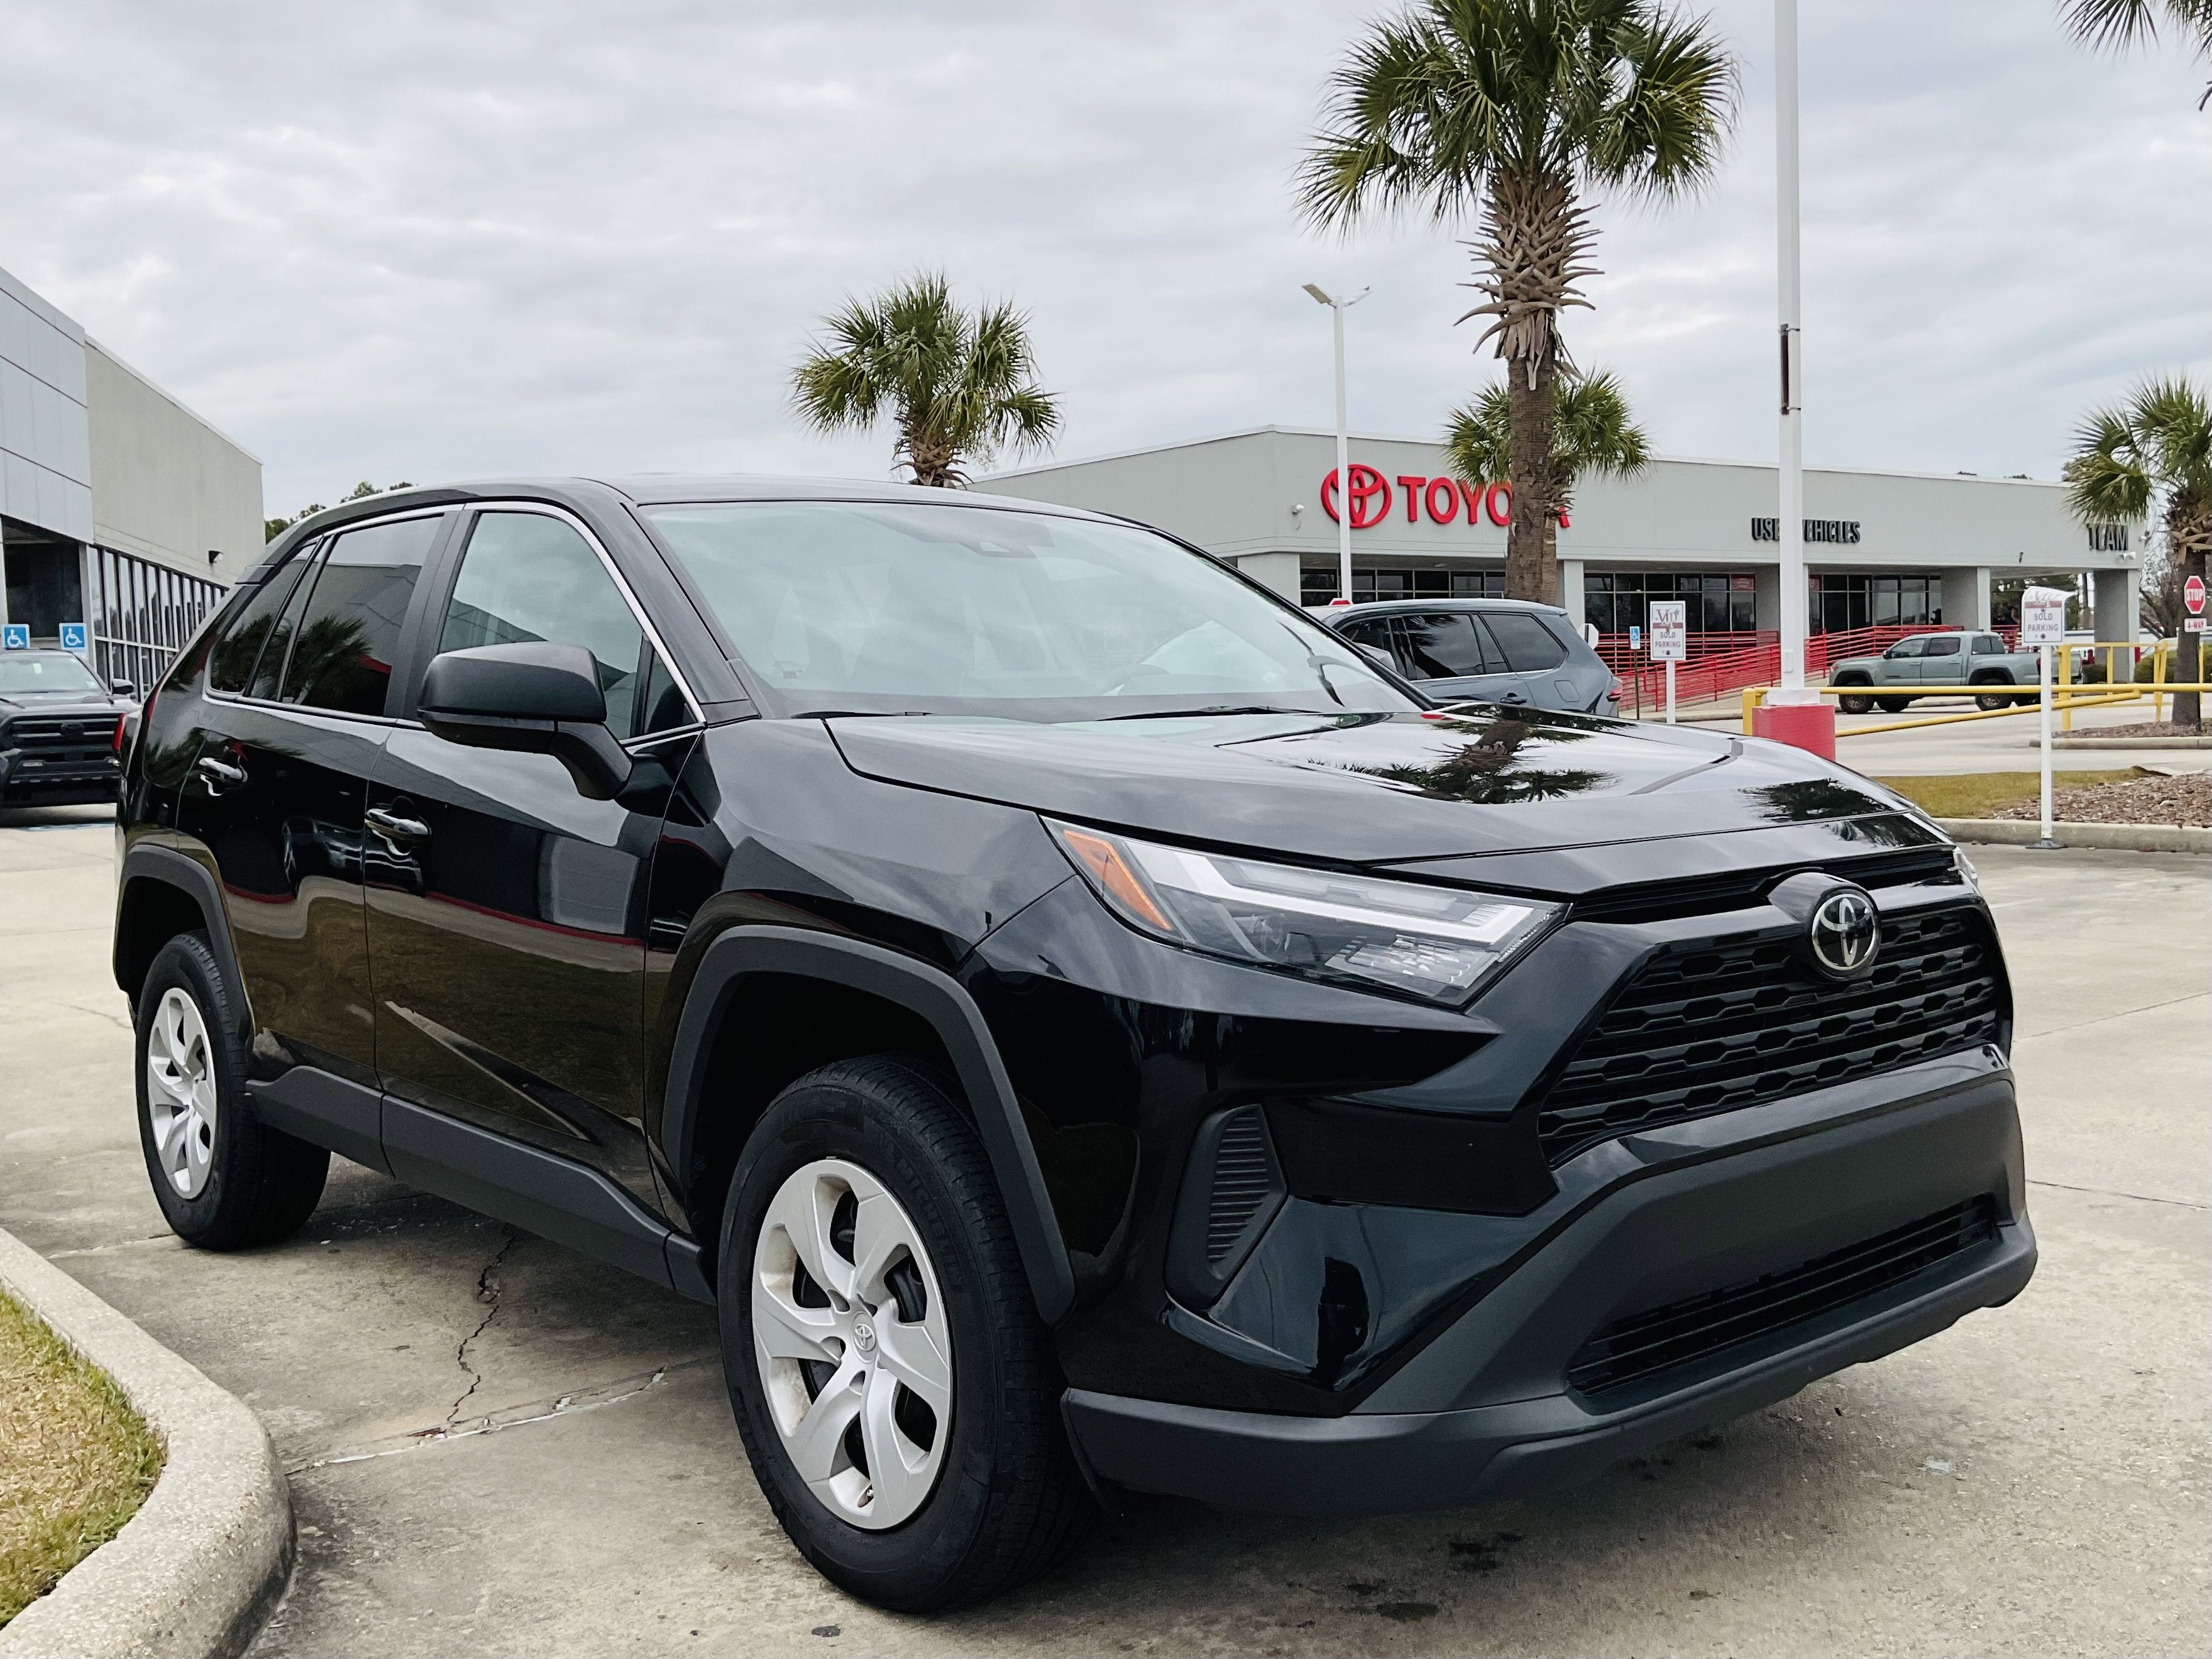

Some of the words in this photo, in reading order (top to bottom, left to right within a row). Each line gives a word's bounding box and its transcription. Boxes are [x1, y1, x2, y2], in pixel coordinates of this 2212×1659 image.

[1397, 475, 1570, 528] TOYO
[1751, 517, 1780, 541] USE
[1802, 519, 1861, 543] EHICLES
[2086, 523, 2129, 551] TEAM
[2186, 588, 2204, 602] STOP
[2027, 624, 2059, 632] PARKING
[2187, 620, 2204, 629] 4-WAY
